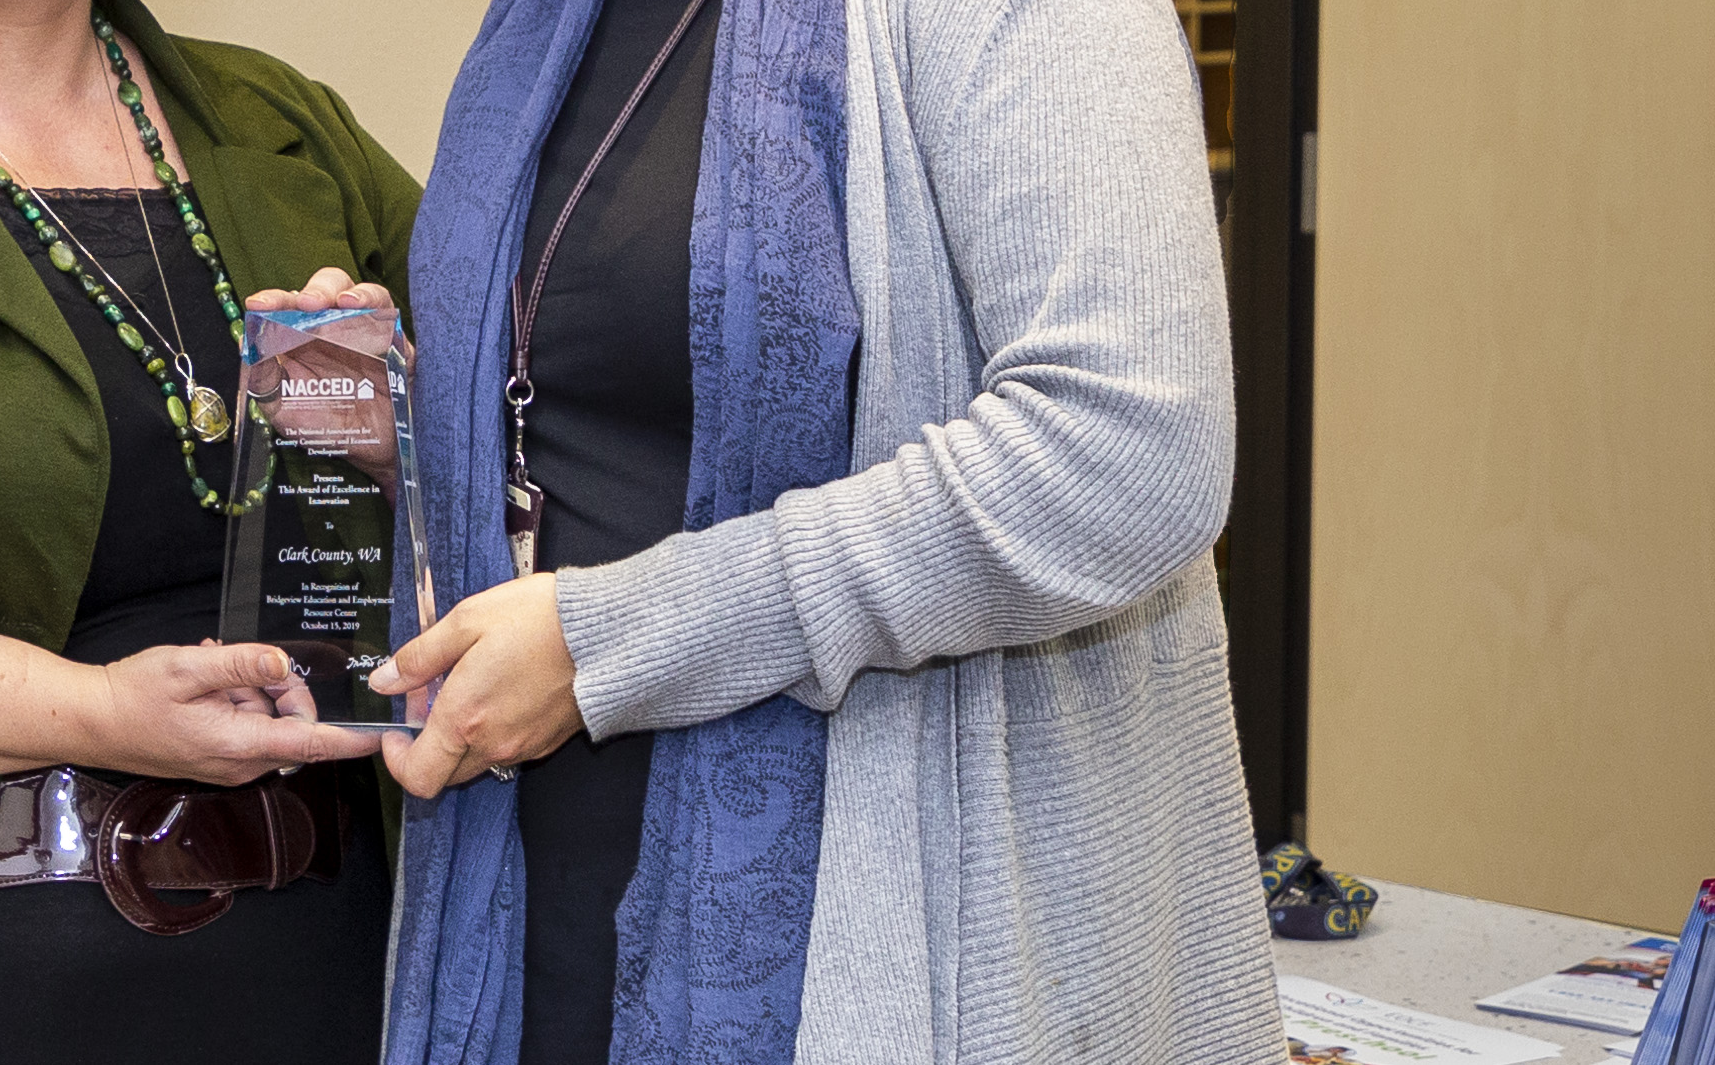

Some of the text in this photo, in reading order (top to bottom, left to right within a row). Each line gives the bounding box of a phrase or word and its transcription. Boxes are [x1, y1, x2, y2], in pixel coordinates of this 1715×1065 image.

[281, 377, 356, 397] NACCED
[298, 427, 325, 436] National
[361, 426, 372, 435] for
[275, 437, 381, 448] County Community and Economic
[307, 447, 349, 457] Development
[313, 474, 345, 483] Presents
[278, 484, 381, 494] This Award of Excellence in
[308, 496, 350, 505] Innovation
[325, 522, 335, 530] To
[278, 545, 382, 566] Clark County, WA
[301, 581, 360, 593] In Recognition of
[266, 595, 395, 607] Bridgeview Education and Employment
[303, 608, 358, 617] Resource Center
[301, 621, 361, 631] October 15, 2019
